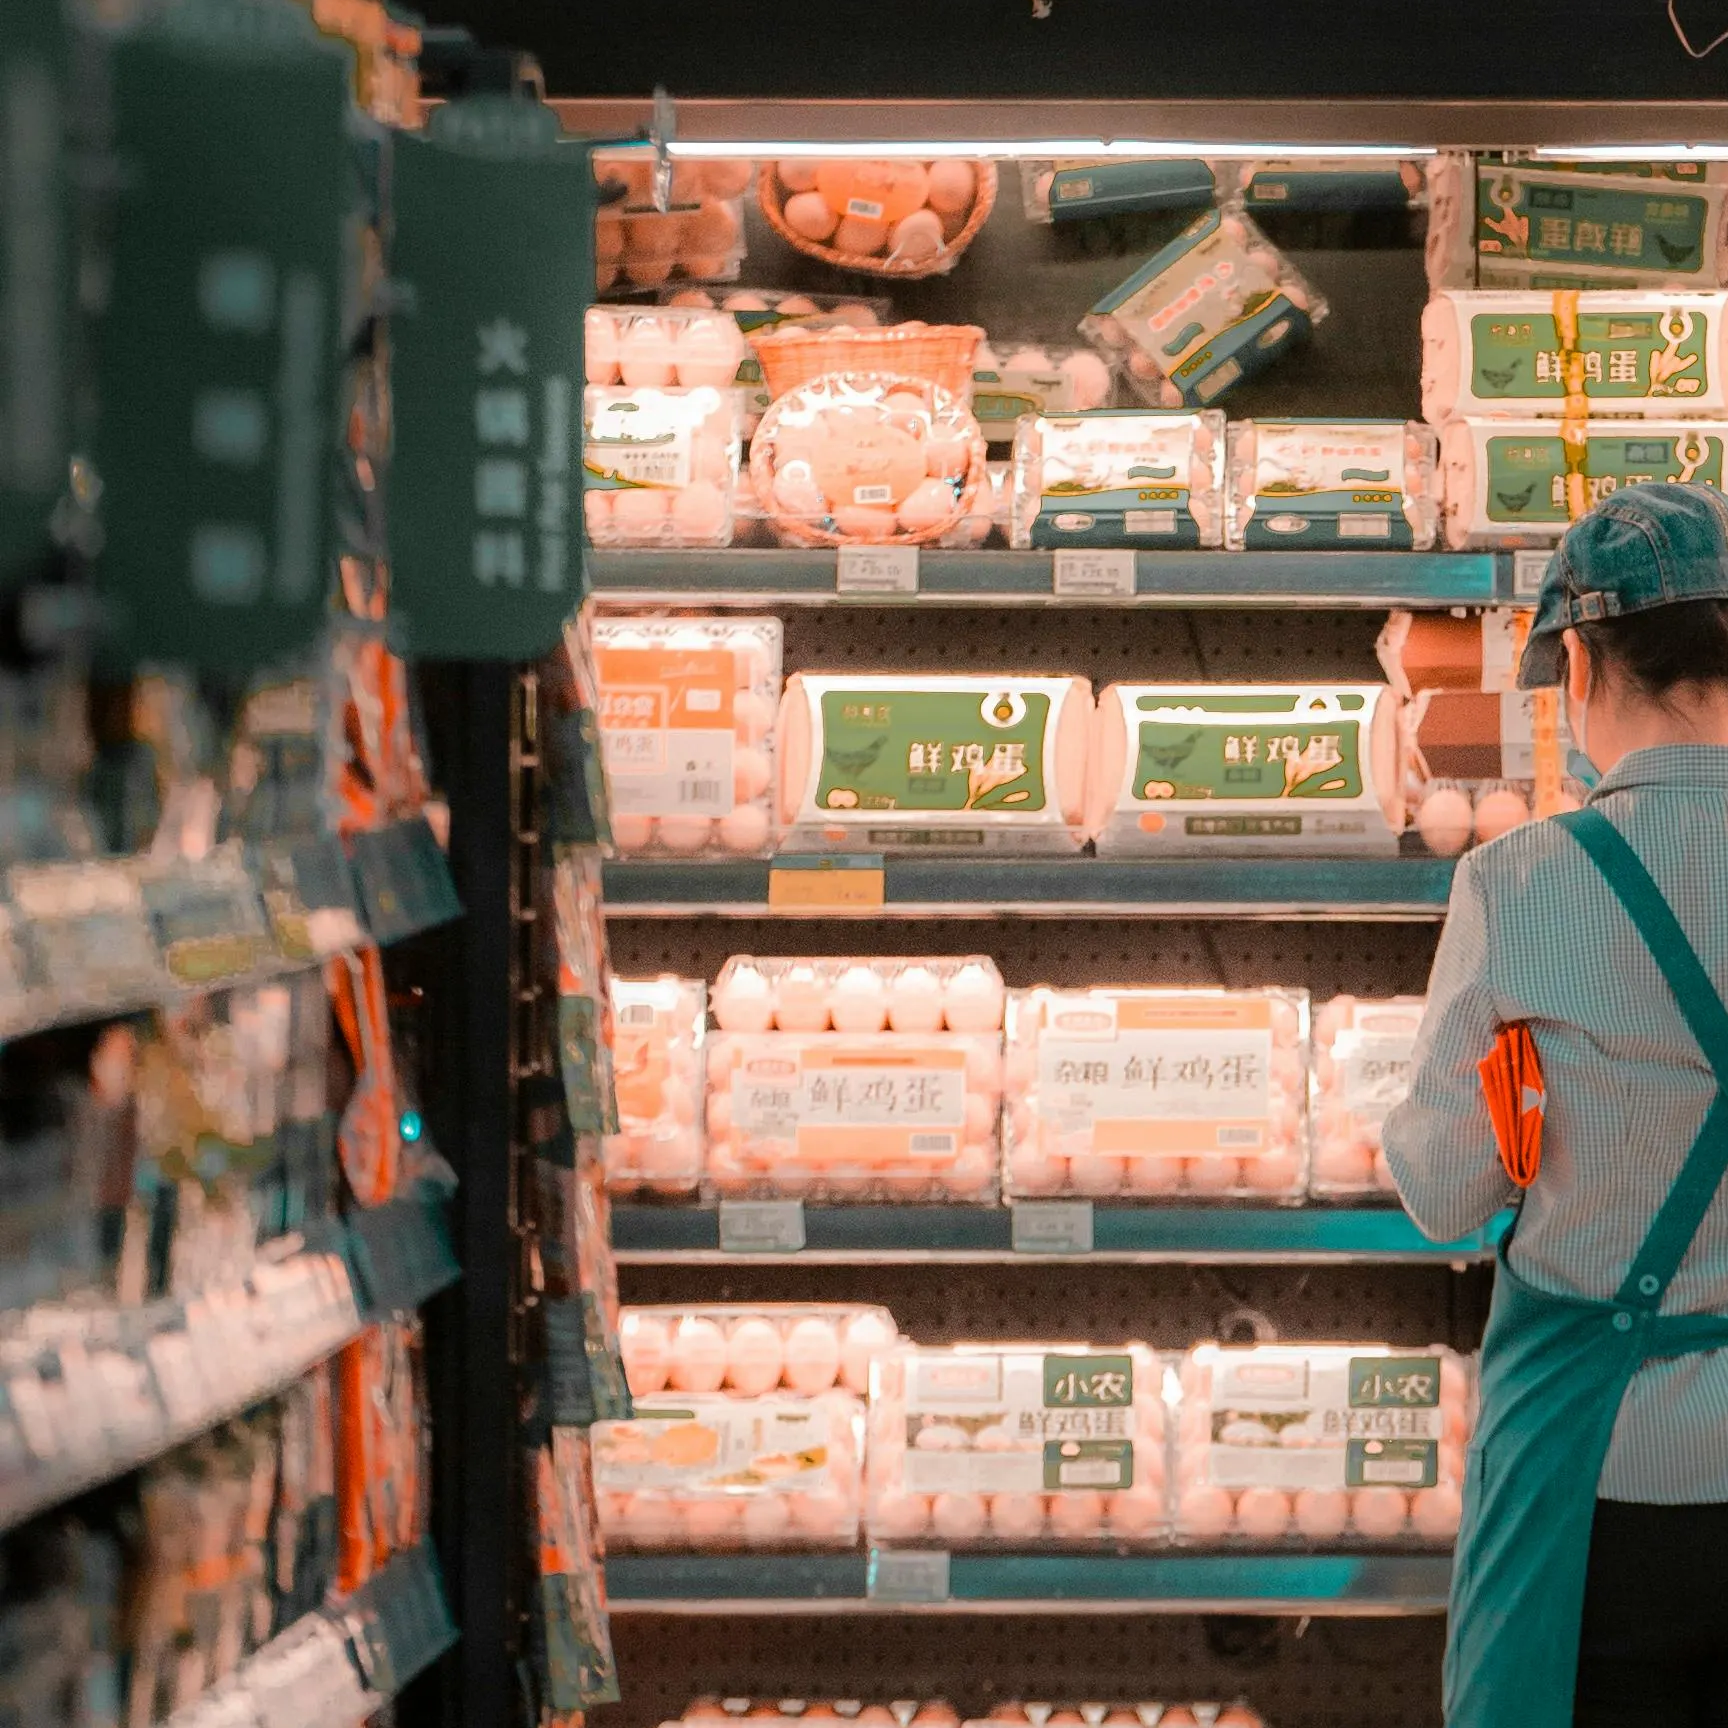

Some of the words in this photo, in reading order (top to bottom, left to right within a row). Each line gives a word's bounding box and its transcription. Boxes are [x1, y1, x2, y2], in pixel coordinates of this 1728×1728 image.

[909, 742, 1027, 774] 鲜鸡蛋
[1223, 735, 1340, 765] 鲜鸡蛋
[1122, 1052, 1261, 1090] 鲜鸡蛋
[808, 1075, 944, 1113] 鲜鸡蛋
[1055, 1371, 1125, 1402] 小农
[1360, 1373, 1431, 1402] 小农
[1018, 1410, 1126, 1437] 鲜鸡蛋
[1322, 1409, 1430, 1436] 鲜鸡蛋
